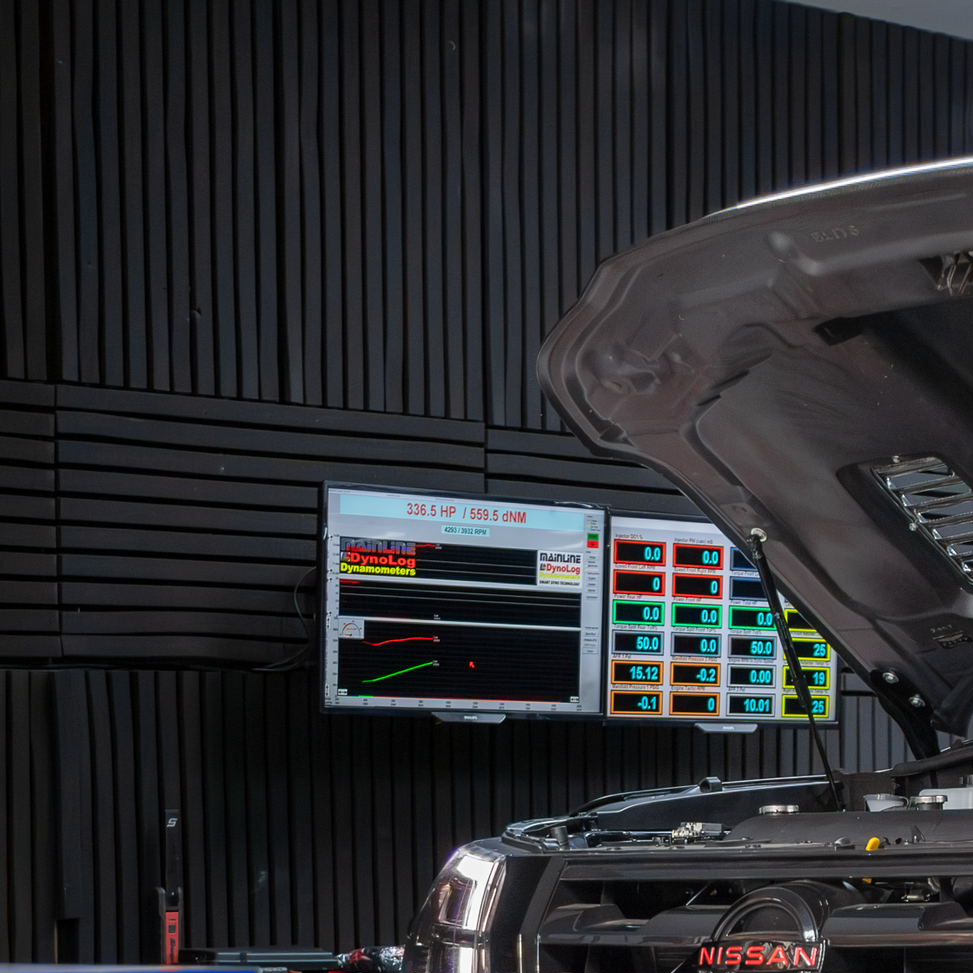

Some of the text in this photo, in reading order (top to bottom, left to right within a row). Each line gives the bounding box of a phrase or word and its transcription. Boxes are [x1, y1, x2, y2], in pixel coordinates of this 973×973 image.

[406, 502, 437, 517] 336.5
[440, 504, 457, 518] HP
[469, 507, 499, 522] 559.5
[502, 509, 527, 524] dNM
[444, 526, 458, 534] 4293
[461, 527, 474, 535] 3932
[474, 528, 487, 536] RPM
[350, 552, 416, 569] DynoLog
[643, 546, 661, 561] 0.0
[701, 550, 719, 565] 0.0
[340, 562, 417, 576] Dynamometers
[546, 563, 581, 575] DynoLog
[652, 576, 660, 592] 0
[710, 580, 718, 595] 0
[642, 606, 660, 621] 0.0
[701, 609, 718, 624] 0.0
[756, 612, 773, 626] 0.0
[636, 636, 659, 651] 50.0
[700, 638, 717, 653] 0.0
[750, 641, 773, 655] 50.0
[813, 643, 826, 657] 25
[629, 665, 659, 680] 15.12
[696, 668, 716, 682] -0.2
[750, 669, 772, 684] 0.00
[812, 672, 825, 686] 19
[637, 695, 657, 710] -0.1
[707, 697, 715, 711] 0
[743, 698, 770, 713] 10.01
[811, 700, 825, 714] 25
[699, 946, 818, 967] NISSAN
